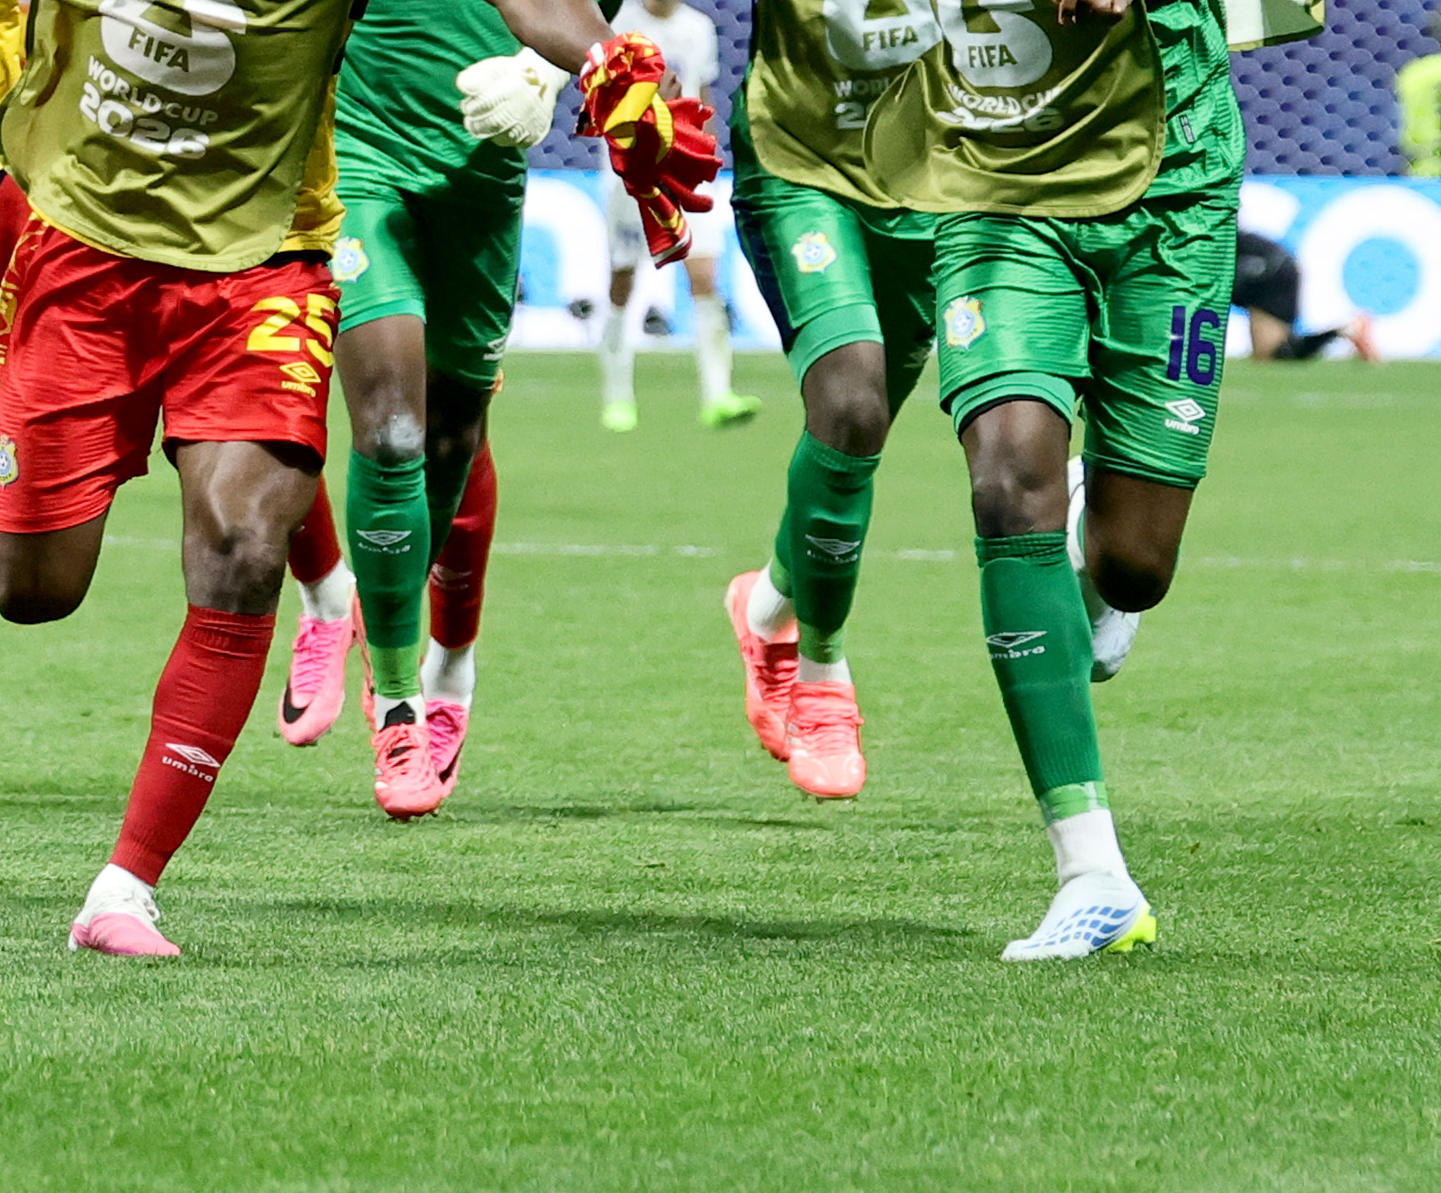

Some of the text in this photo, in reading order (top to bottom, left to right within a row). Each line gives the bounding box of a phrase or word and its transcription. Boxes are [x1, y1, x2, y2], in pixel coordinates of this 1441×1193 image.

[128, 25, 190, 74] FIFA
[862, 25, 918, 52] FIFA
[968, 44, 1019, 68] FIFA
[87, 55, 219, 126] WORLD CUP
[948, 82, 1022, 116] WORLD
[79, 81, 211, 160] 2026
[246, 292, 337, 369] 25
[1167, 305, 1221, 386] 16
[160, 755, 215, 783] umbro
